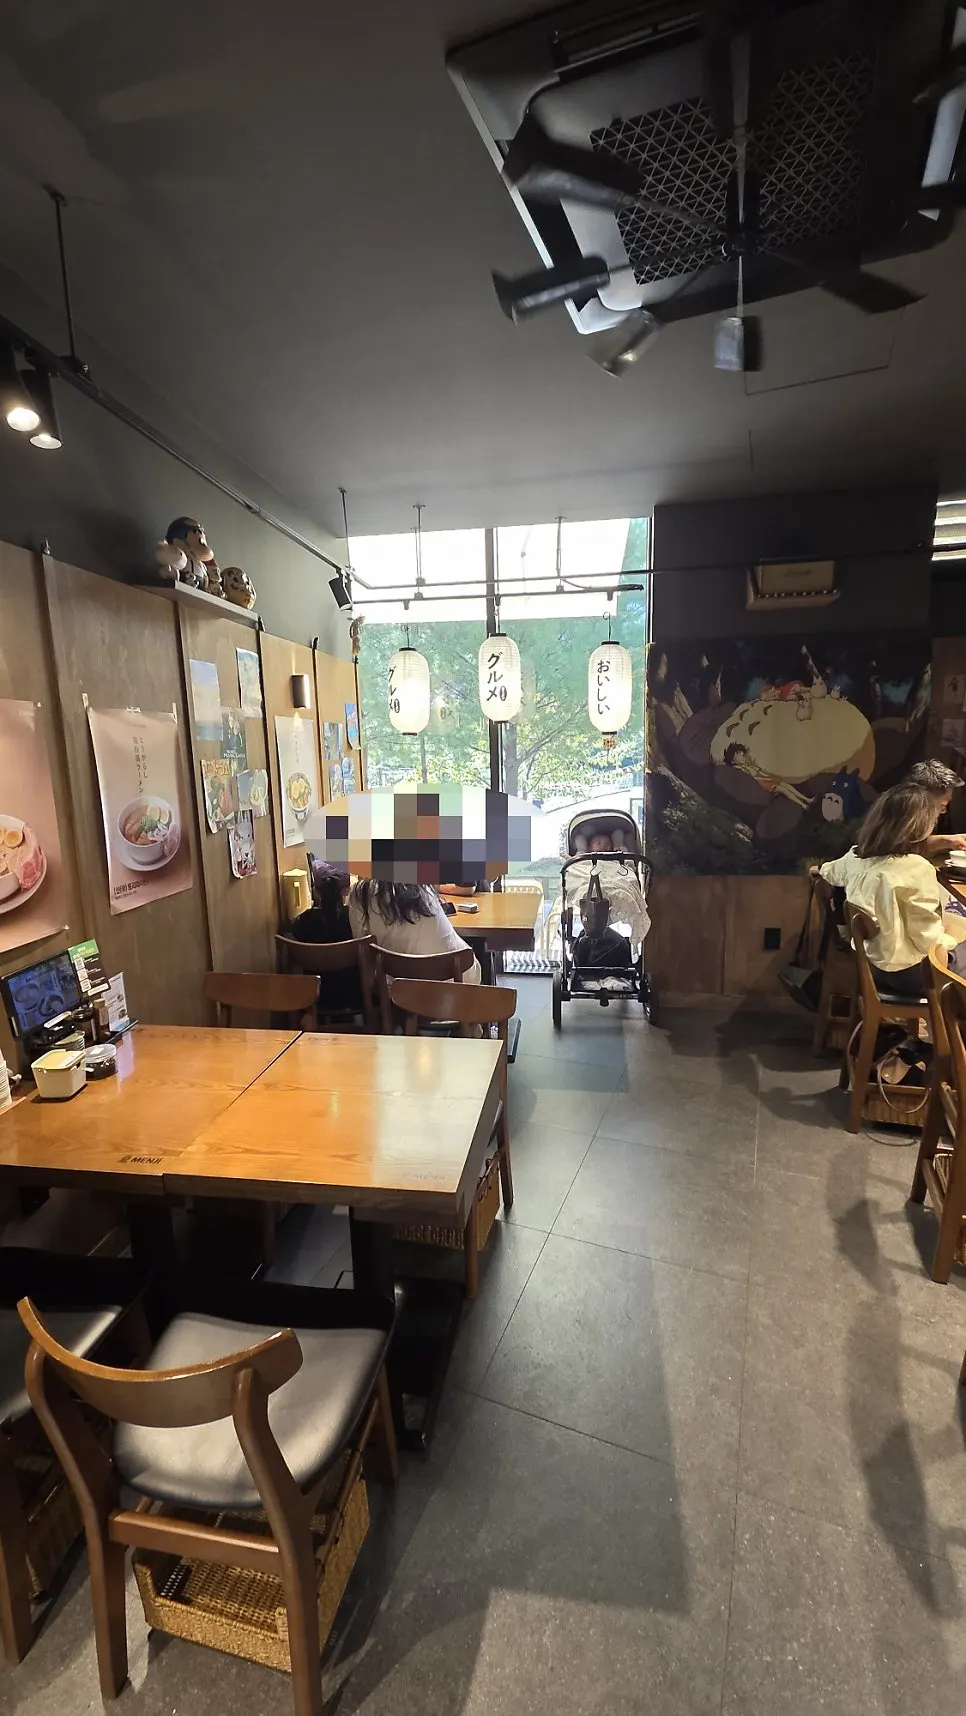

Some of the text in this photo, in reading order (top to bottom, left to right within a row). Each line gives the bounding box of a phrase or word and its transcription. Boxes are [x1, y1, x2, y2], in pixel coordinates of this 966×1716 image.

[486, 651, 503, 701] グルメ
[597, 659, 611, 715] おいしい
[130, 1156, 163, 1165] MENJI
